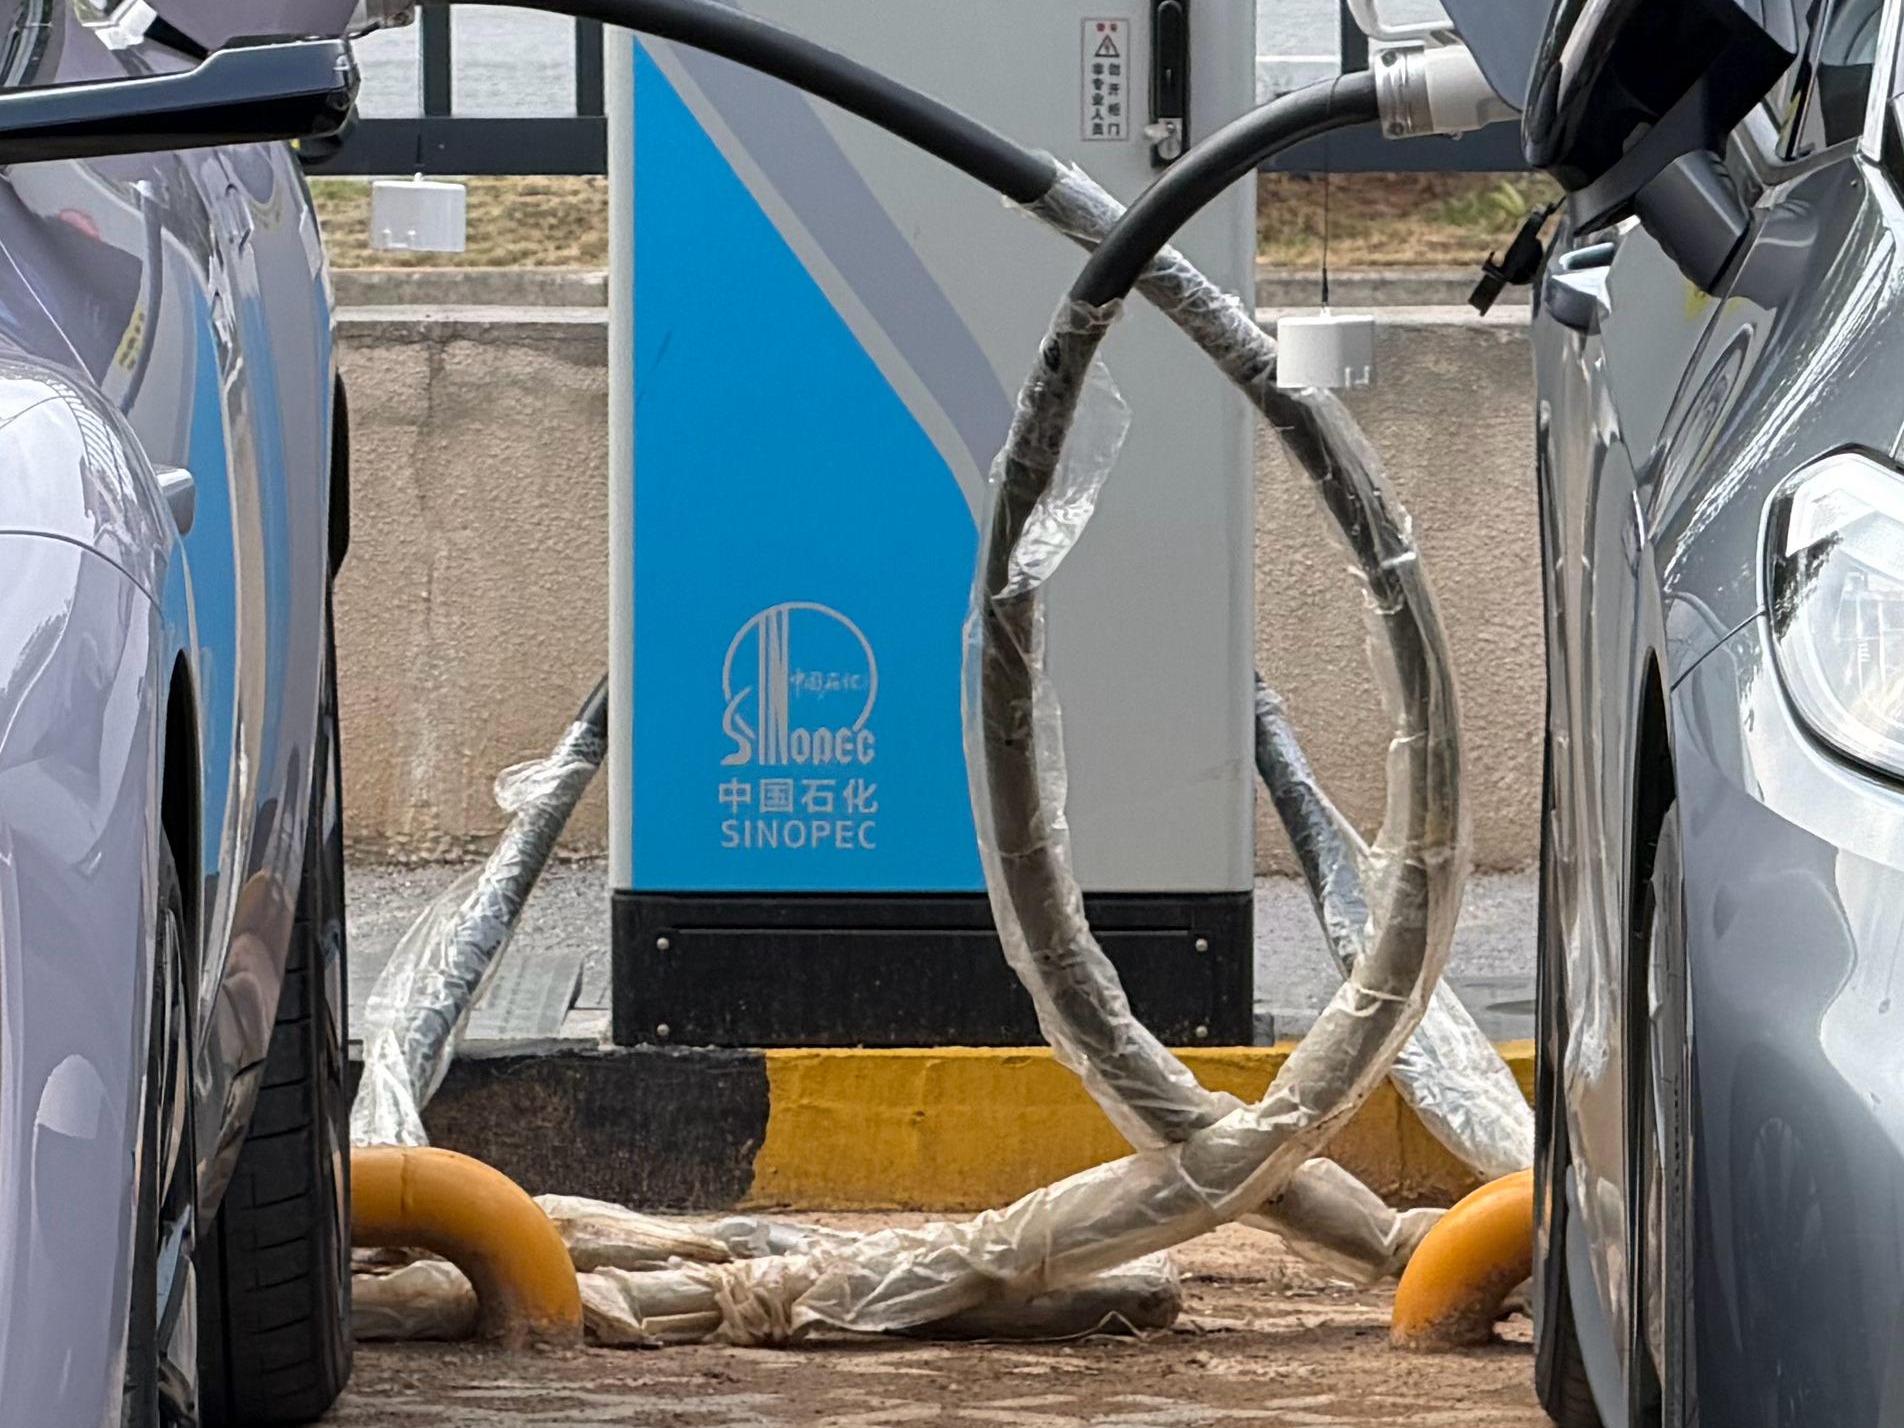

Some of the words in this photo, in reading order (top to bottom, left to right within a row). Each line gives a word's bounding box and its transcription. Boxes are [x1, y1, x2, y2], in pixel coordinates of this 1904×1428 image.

[718, 776, 880, 815] 中国石化
[720, 818, 877, 851] SINOPEC
